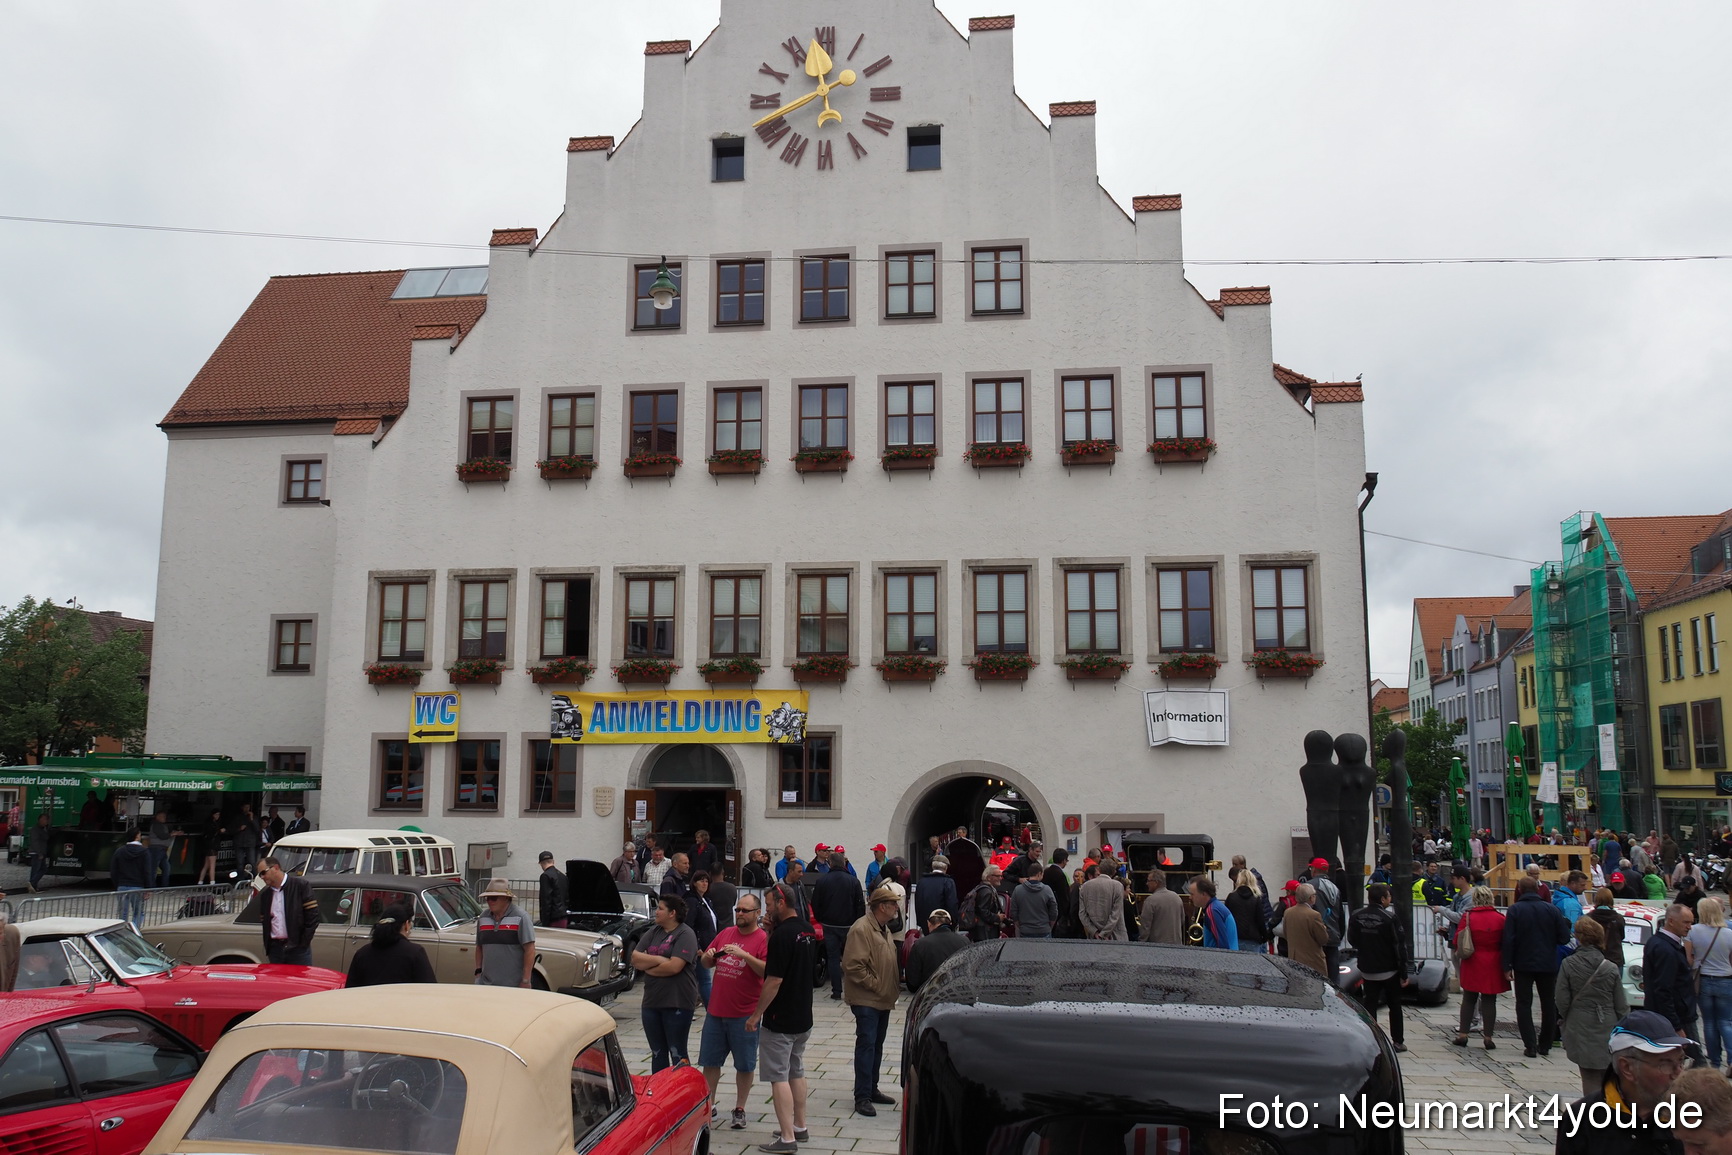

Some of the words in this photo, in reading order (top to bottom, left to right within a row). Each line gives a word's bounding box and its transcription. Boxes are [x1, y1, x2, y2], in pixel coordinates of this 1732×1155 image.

[414, 693, 458, 727] WC
[587, 699, 763, 735] ANMELDUNG
[1152, 710, 1223, 723] Information
[0, 775, 36, 785] eumarkter
[37, 775, 80, 787] Lammsbräu
[103, 778, 158, 789] Neumarkter
[159, 780, 213, 790] Lammsbräu
[262, 781, 290, 790] Neumarkter
[290, 781, 317, 790] Lammsbräu
